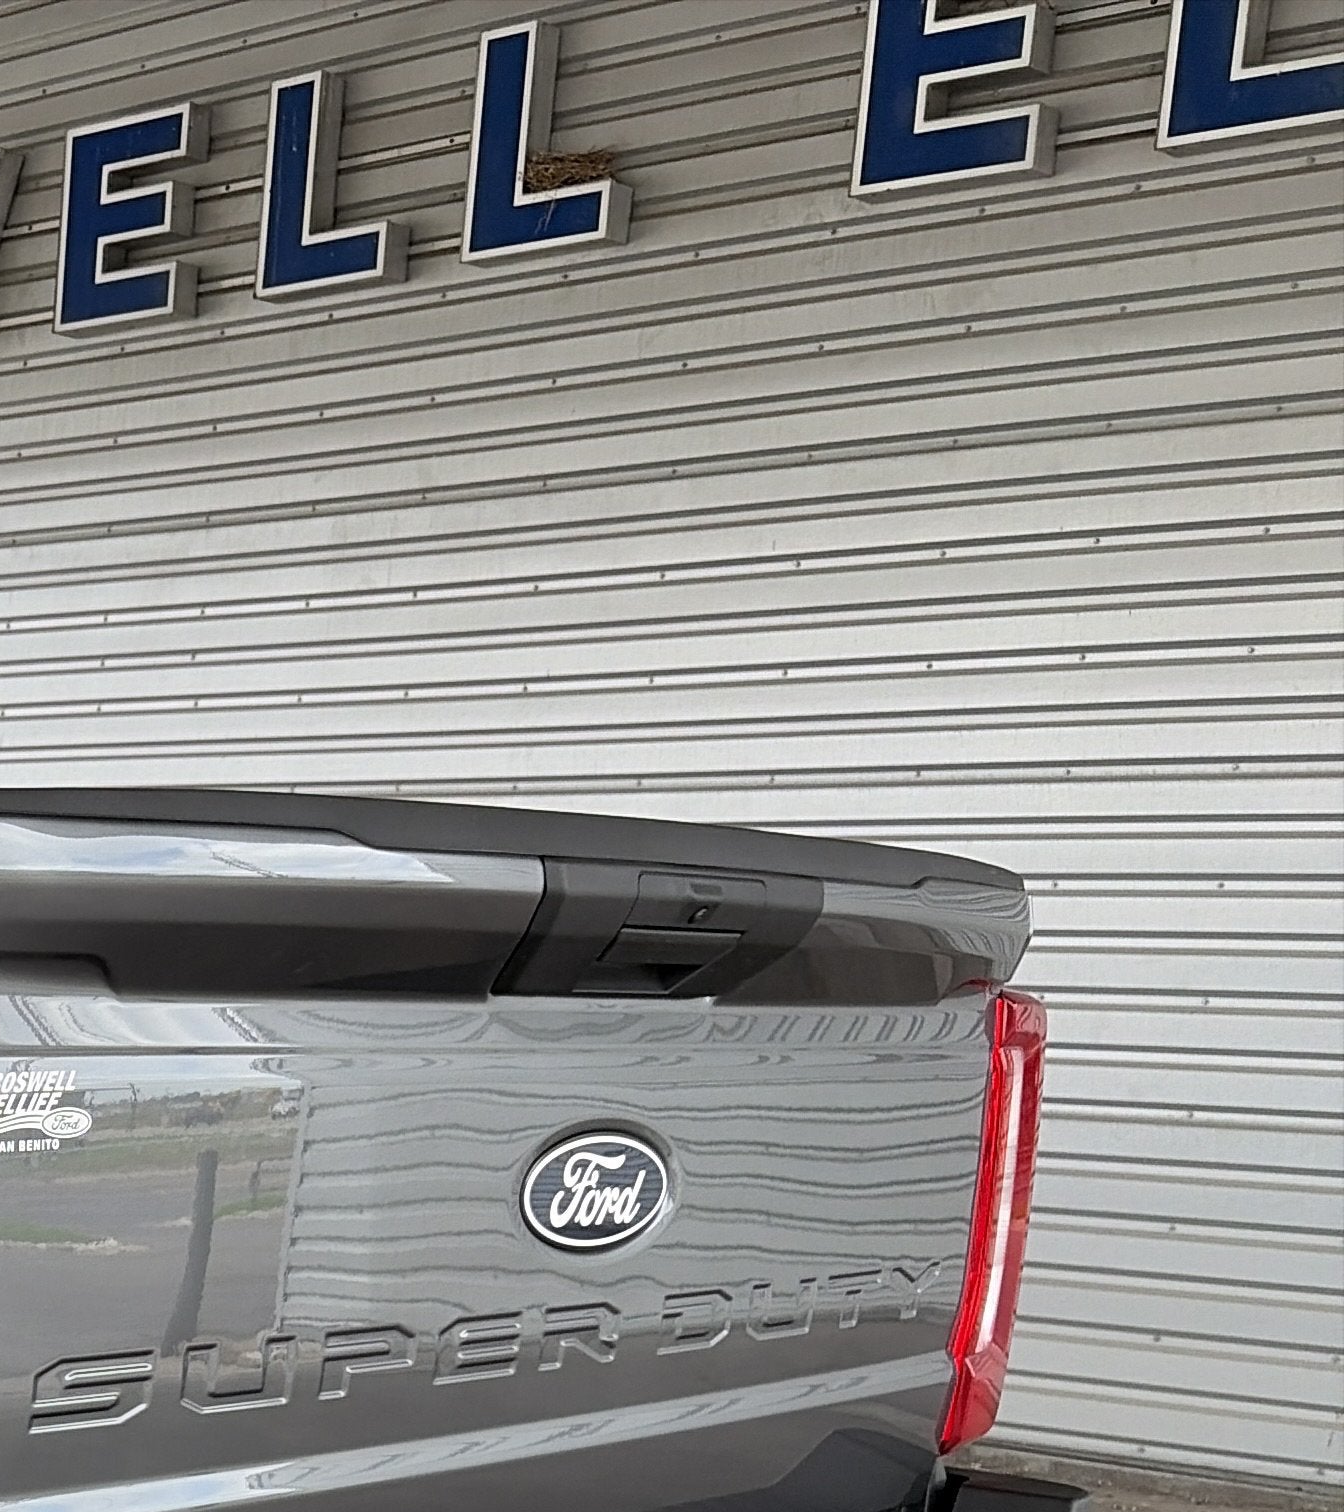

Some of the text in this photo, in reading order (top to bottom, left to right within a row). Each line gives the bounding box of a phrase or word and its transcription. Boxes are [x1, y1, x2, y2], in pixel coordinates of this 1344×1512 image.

[18, 1138, 60, 1152] BENITO
[549, 1151, 646, 1228] Ford
[28, 1260, 942, 1434] SUPER DUTY
